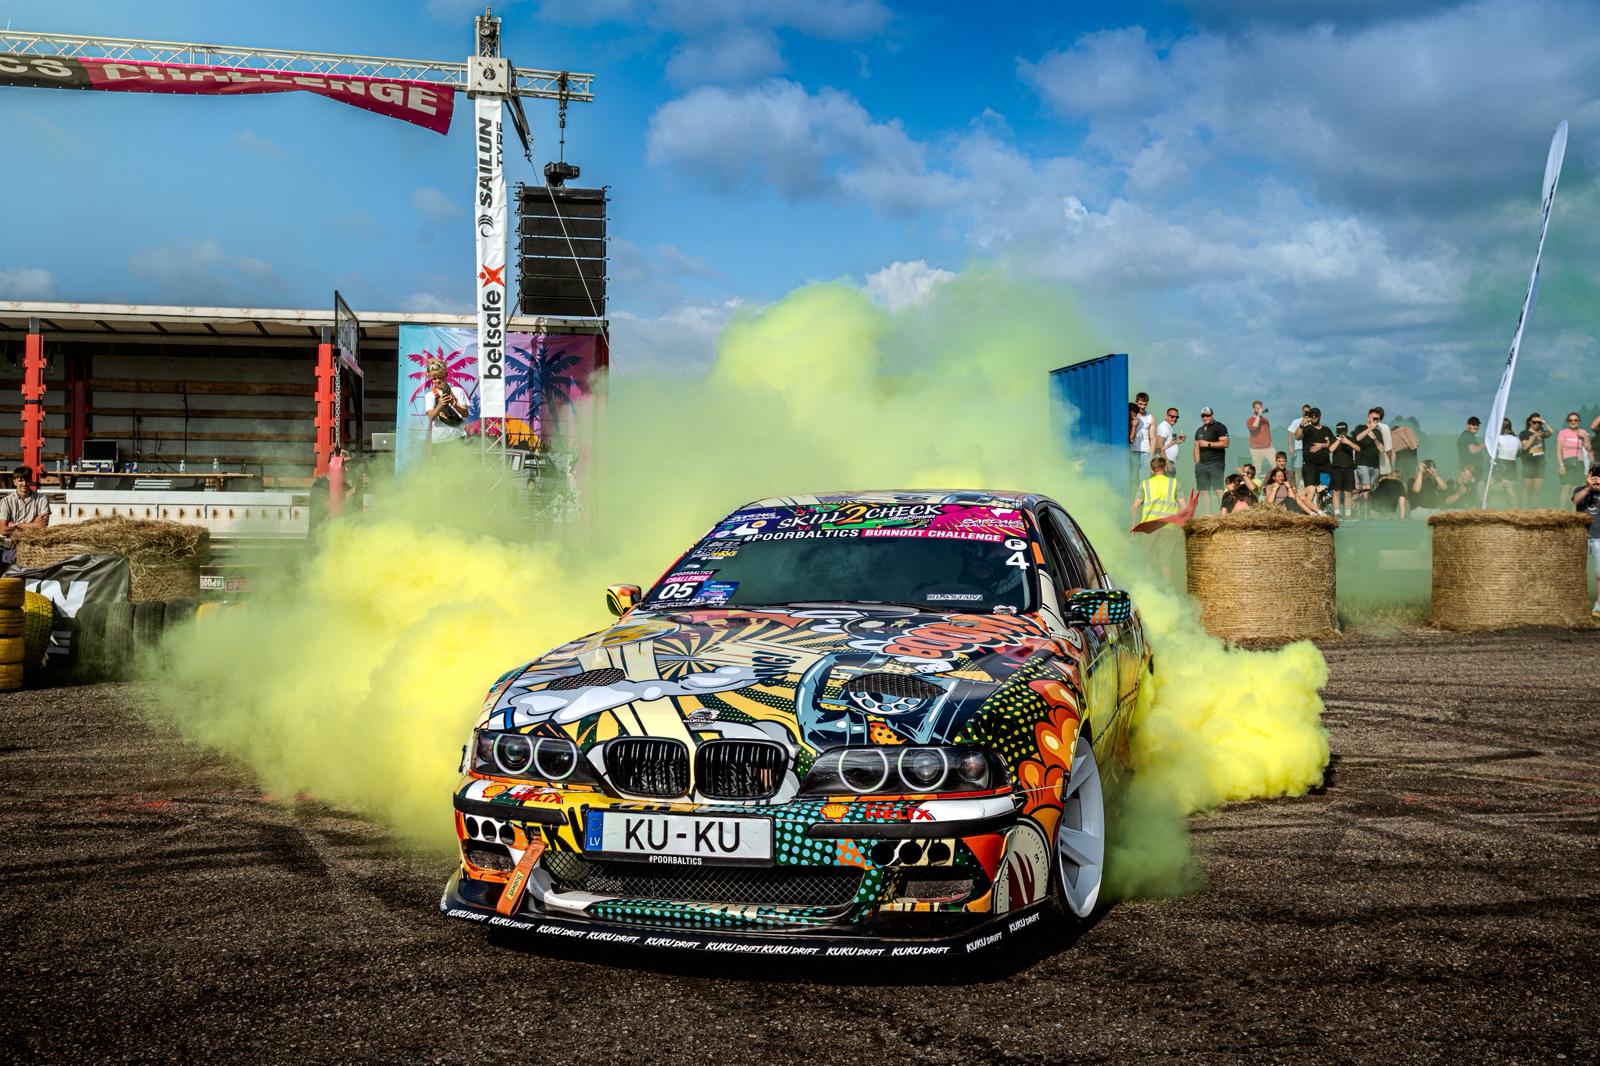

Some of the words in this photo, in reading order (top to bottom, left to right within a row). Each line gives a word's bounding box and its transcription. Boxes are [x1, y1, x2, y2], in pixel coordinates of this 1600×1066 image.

[478, 117, 493, 208] SAILUN
[482, 289, 503, 379] betsafe
[744, 528, 860, 542] #POORBALTICS
[864, 529, 926, 538] BURNOUT
[927, 529, 1002, 542] CHALLENGE
[1005, 551, 1030, 570] 4
[658, 582, 699, 600] 05
[865, 808, 933, 821] HELIX
[589, 837, 600, 846] LV
[625, 818, 741, 853] KU-KU
[648, 855, 703, 866] #POORBALTICS
